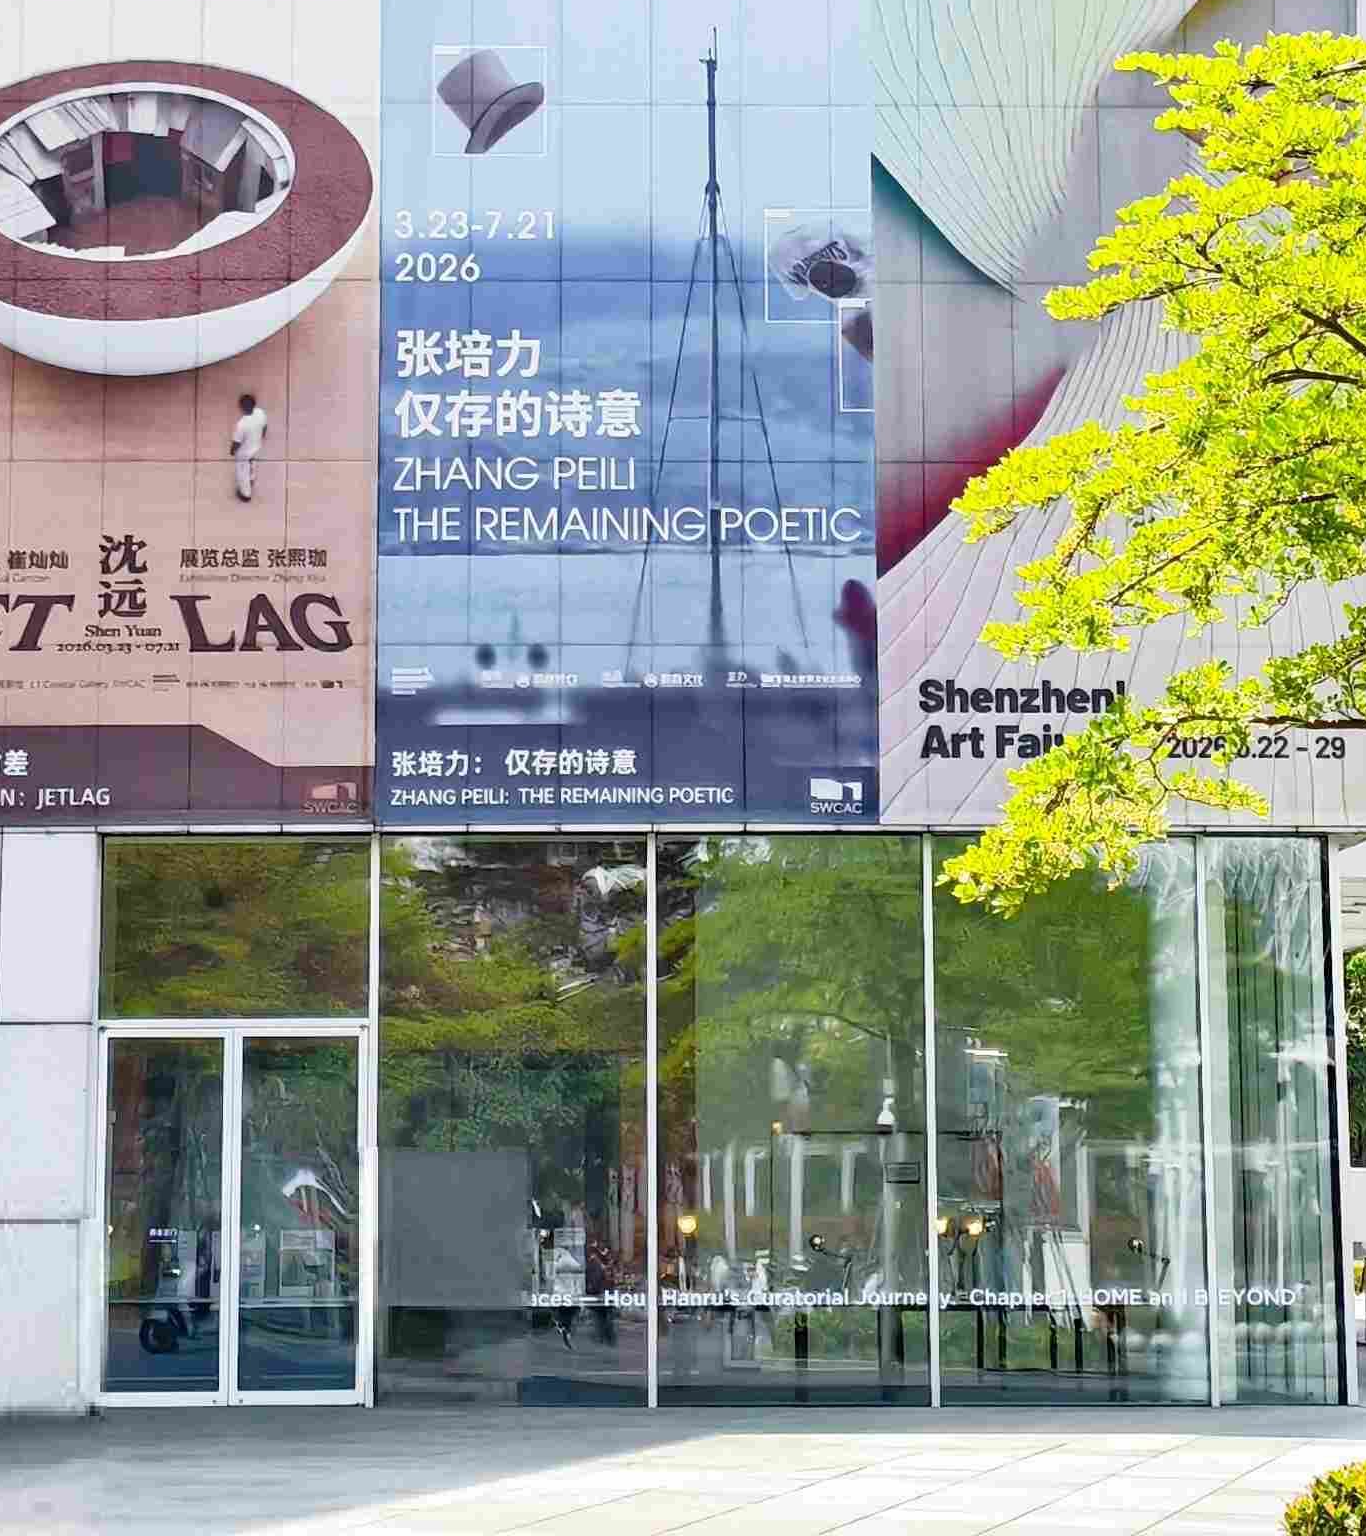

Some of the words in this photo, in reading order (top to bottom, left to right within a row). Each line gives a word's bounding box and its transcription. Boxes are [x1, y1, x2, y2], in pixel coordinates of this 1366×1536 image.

[395, 211, 555, 240] 3.23-7.21
[394, 254, 481, 283] 2026
[396, 330, 541, 378] 张培力
[395, 390, 643, 438] 仅存的诗意
[393, 456, 541, 491] ZHANG
[553, 456, 635, 490] PEILI
[393, 507, 461, 542] THE
[475, 507, 706, 542] REMAINING
[719, 507, 862, 542] POETIC
[180, 548, 260, 569] 展览总监
[98, 534, 149, 619] 沈远
[85, 624, 121, 637] Shen
[124, 624, 162, 637] Yuan
[170, 593, 353, 652] LAG
[921, 725, 985, 759] Art
[1315, 736, 1346, 759] 29
[36, 787, 111, 809] JETLAG
[390, 788, 456, 806] ZHANG
[461, 788, 509, 806] PEILI:
[518, 787, 555, 805] THE
[560, 787, 664, 805] REMAINING
[668, 787, 734, 804] POETIC
[811, 801, 863, 814] SWCAC
[604, 1289, 646, 1306] Hou
[662, 1288, 740, 1306] Hanru's
[747, 1288, 849, 1306] Curatorial
[969, 1288, 1053, 1308] Chaper
